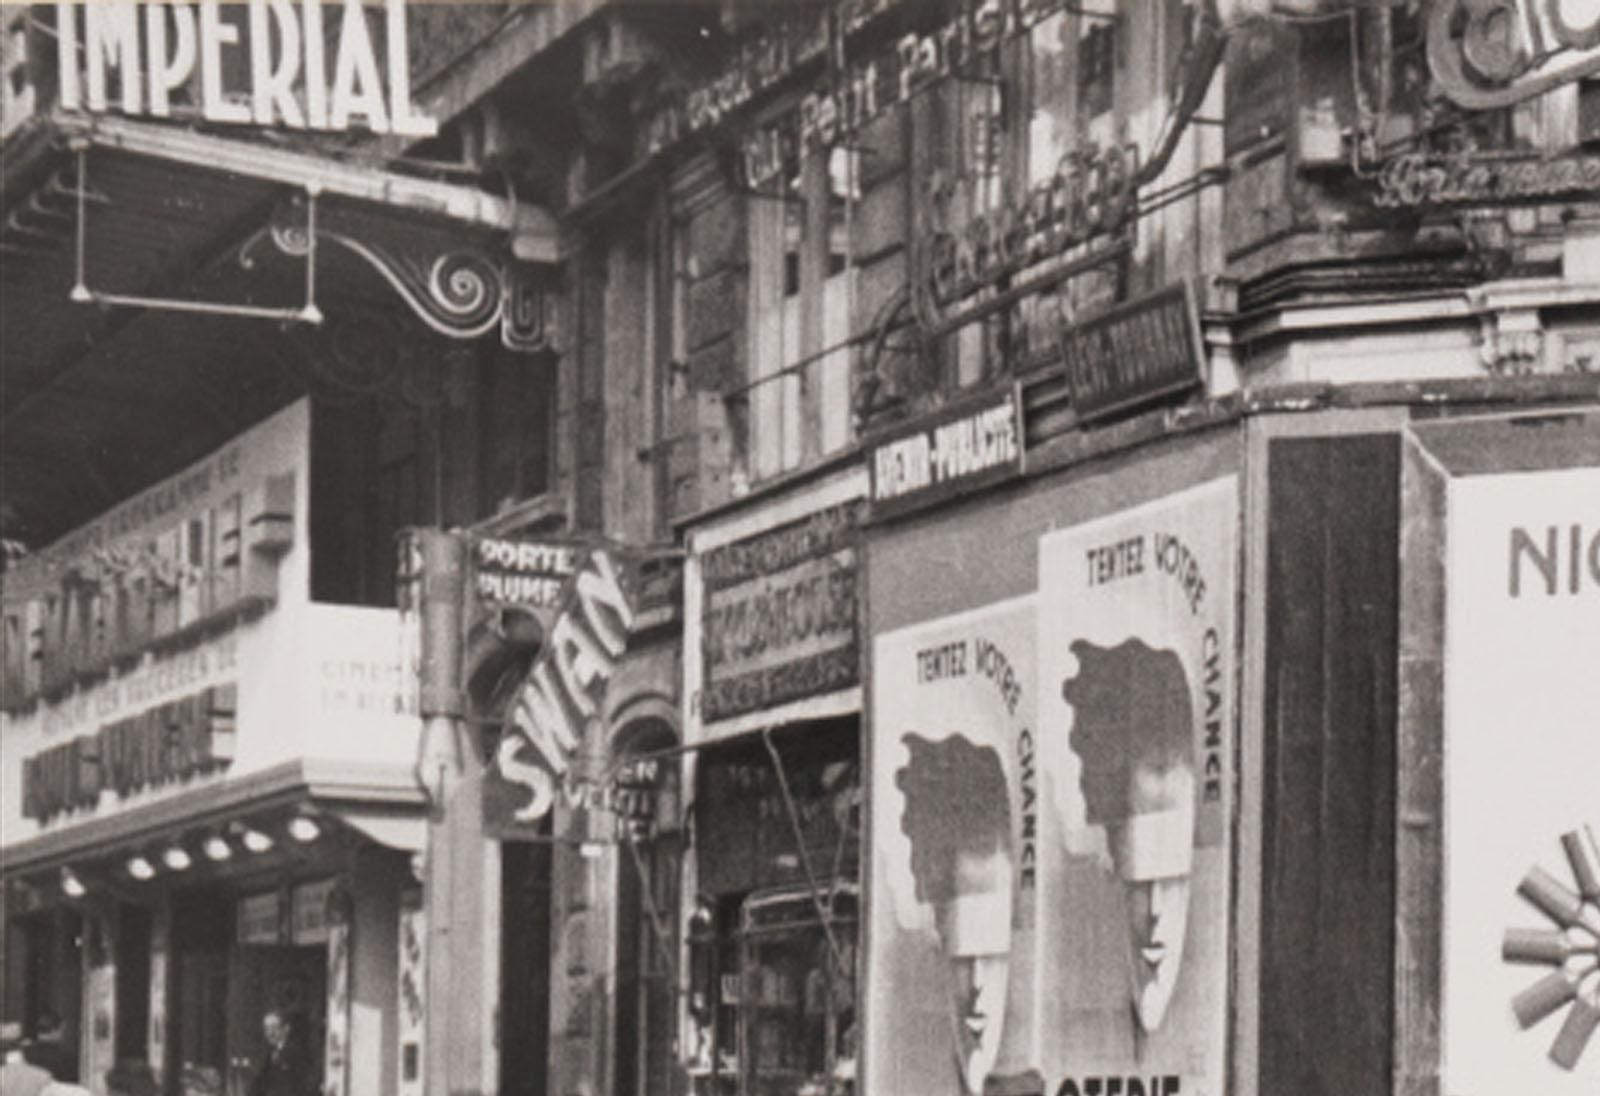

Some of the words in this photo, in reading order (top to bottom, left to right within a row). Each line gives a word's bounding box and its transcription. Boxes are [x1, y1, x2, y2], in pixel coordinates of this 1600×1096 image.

[57, 3, 438, 136] IMPERIAL
[481, 539, 576, 574] PORTE
[1087, 534, 1145, 588] TENTEZ
[1152, 531, 1207, 616] VOTRE
[1202, 626, 1222, 804] CHANCE
[497, 549, 633, 821] SWAN
[916, 640, 967, 685] TENTEZ
[974, 636, 1022, 717] VOTRE
[1016, 728, 1037, 890] CHANCE
